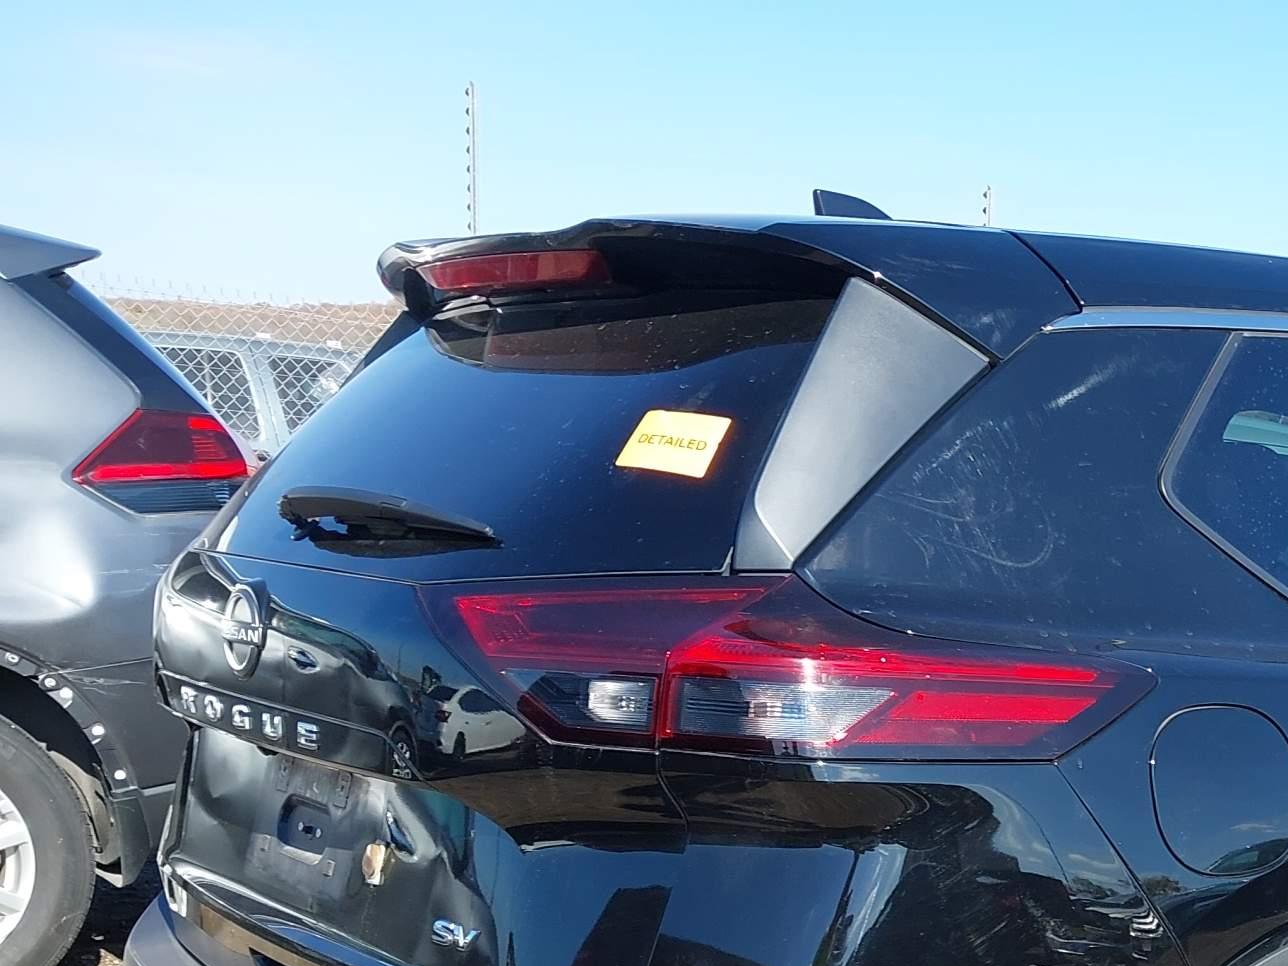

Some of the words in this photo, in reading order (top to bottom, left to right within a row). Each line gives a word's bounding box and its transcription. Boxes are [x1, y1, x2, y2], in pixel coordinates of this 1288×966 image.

[638, 433, 708, 451] DETAILED
[180, 685, 320, 751] ROGUE
[431, 919, 481, 952] SV
